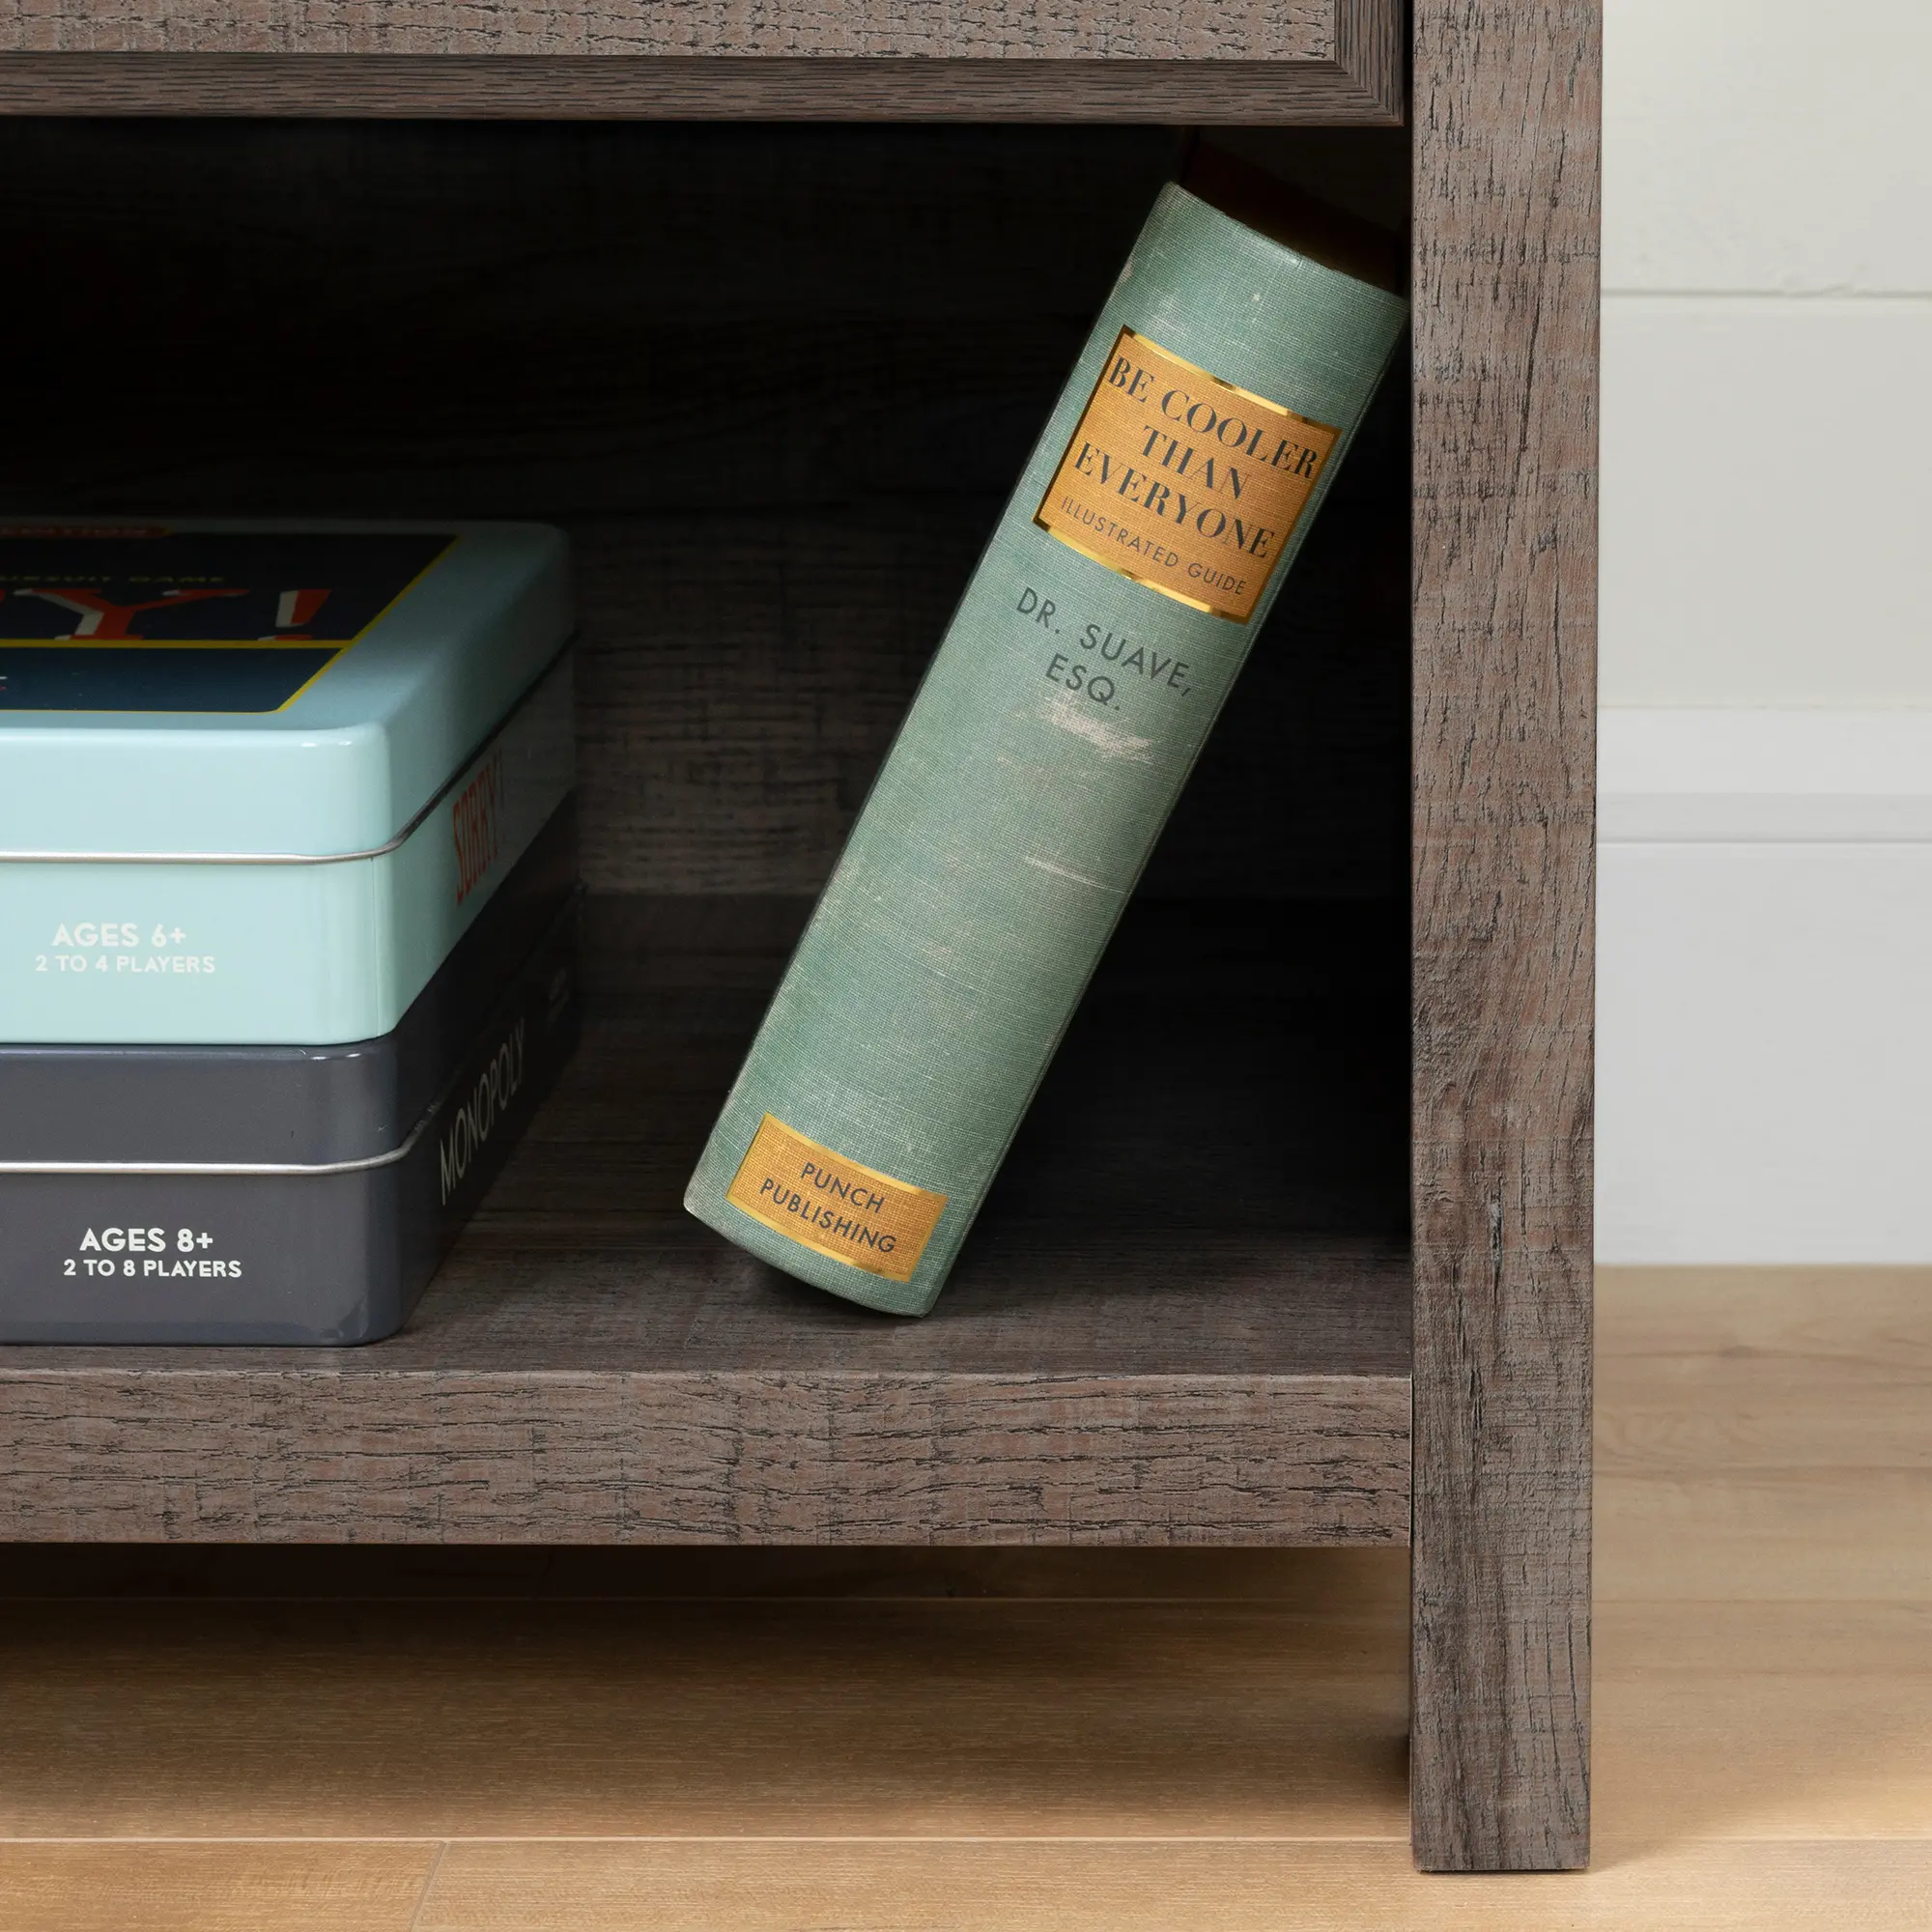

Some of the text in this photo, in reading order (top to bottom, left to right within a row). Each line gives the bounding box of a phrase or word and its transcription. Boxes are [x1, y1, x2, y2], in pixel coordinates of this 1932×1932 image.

[1108, 355, 1319, 480] BE COOLER
[1141, 424, 1250, 500] THAN
[1073, 440, 1275, 559] EVERYONE
[1061, 496, 1247, 596] ILLUSTRATED GUIDE
[0, 587, 333, 640] Y!
[1016, 585, 1192, 697] DR. SUAVE,
[1044, 652, 1122, 711] ESQ.
[35, 954, 216, 974] 2 TO 4 PLAYERS
[51, 922, 187, 948] AGES 6+
[439, 1016, 526, 1207] MONOPOLY
[758, 1178, 898, 1254] PUBLISHING
[800, 1161, 886, 1214] PUNCH
[63, 1259, 242, 1279] 2 TO 8 PLAYERS
[79, 1228, 214, 1253] AGES 8+
